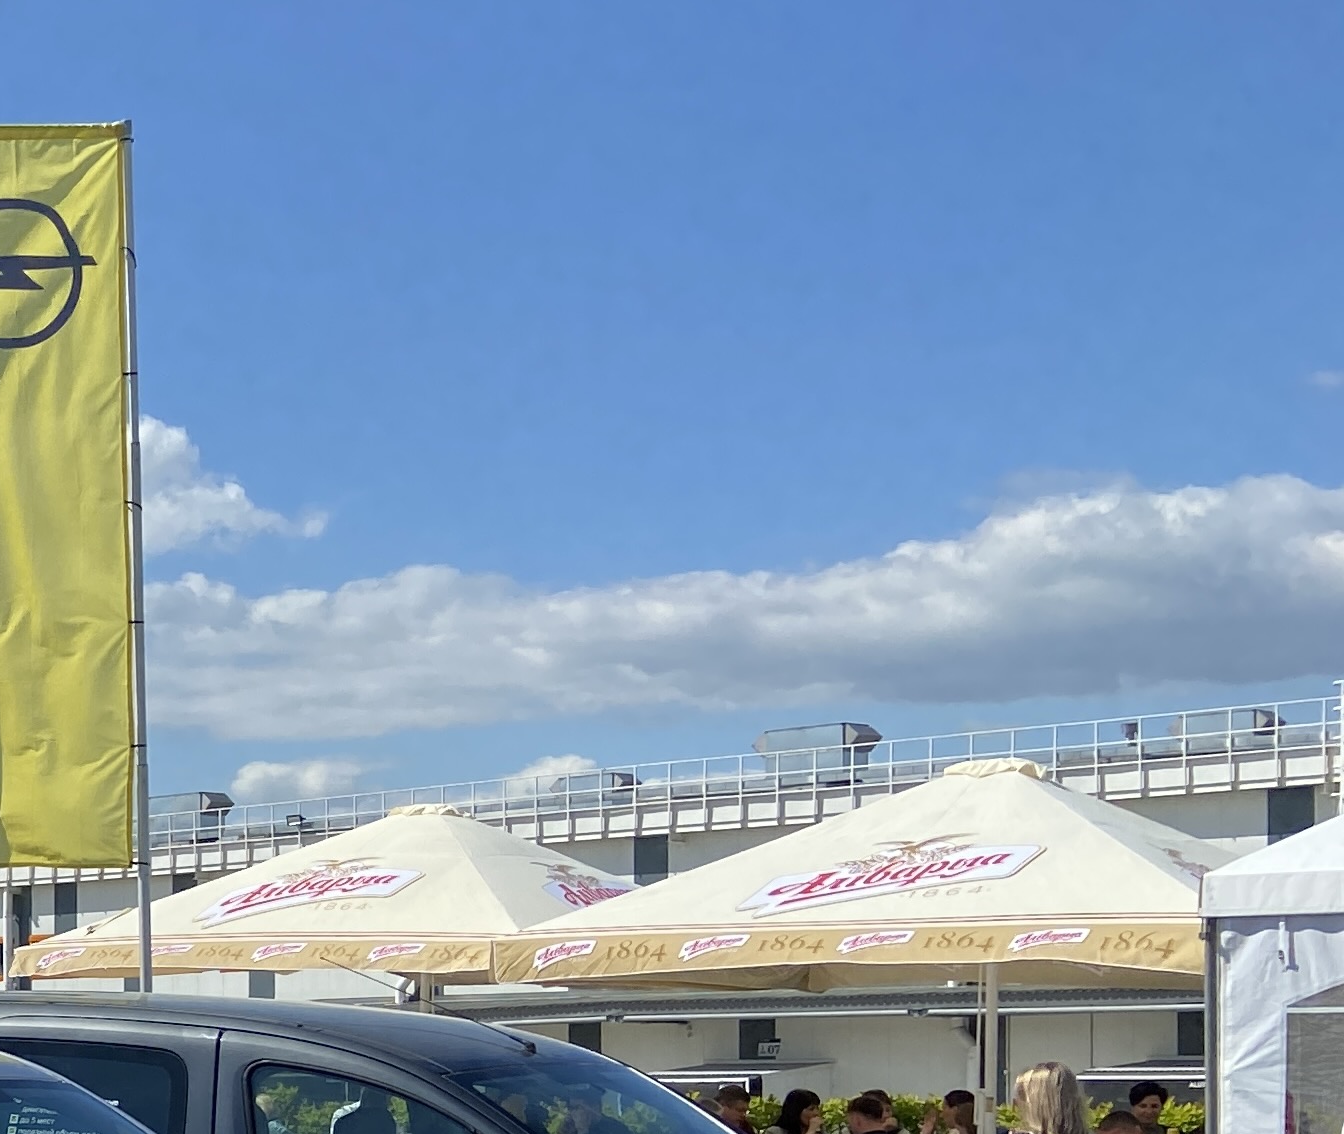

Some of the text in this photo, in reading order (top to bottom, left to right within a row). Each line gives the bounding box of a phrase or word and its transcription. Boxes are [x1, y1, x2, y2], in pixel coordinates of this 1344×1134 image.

[605, 940, 667, 962] 1864
[758, 934, 825, 954] 1864
[923, 931, 996, 953] 1864
[1099, 930, 1176, 960] 1864
[89, 948, 133, 963] 1864
[197, 945, 245, 961] 1864
[311, 943, 361, 962] 1864
[429, 943, 480, 963] 1864
